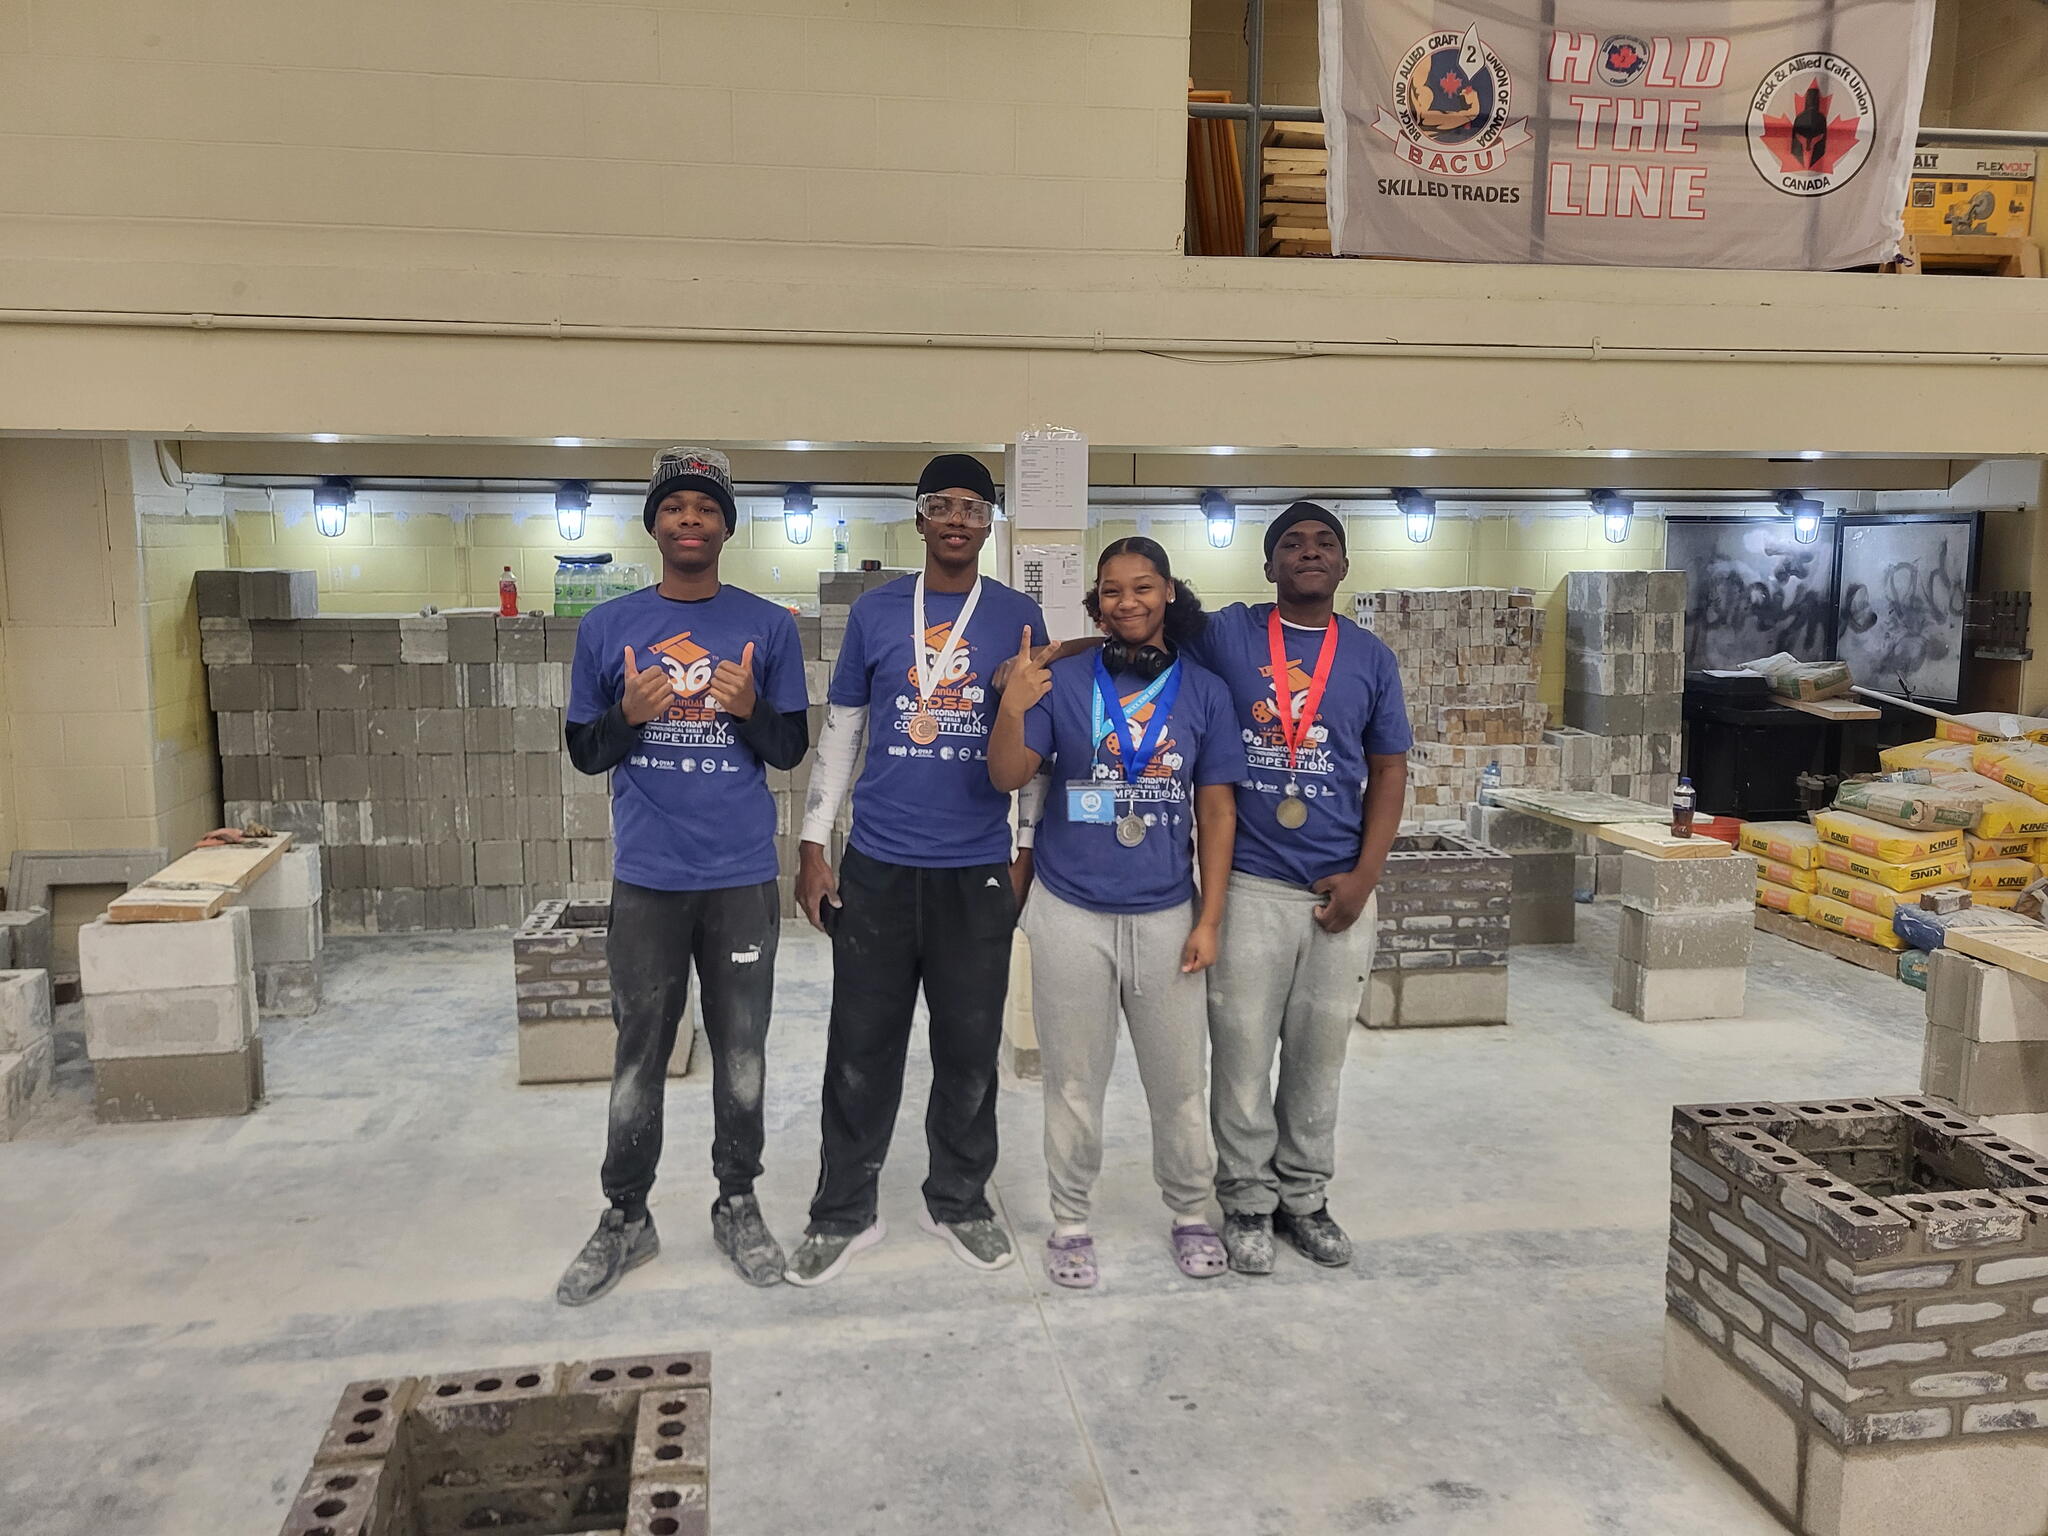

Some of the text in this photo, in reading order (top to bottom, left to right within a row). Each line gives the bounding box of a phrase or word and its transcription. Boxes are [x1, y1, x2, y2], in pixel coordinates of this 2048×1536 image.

[1466, 45, 1476, 63] 2
[1396, 34, 1459, 142] BRICK AND ALLIED CRAFT
[1754, 56, 1869, 116] Brick & Allied Craft Union
[1477, 52, 1508, 148] UNION OF CANADA
[1570, 94, 1701, 153] THE
[1408, 145, 1493, 173] BACU
[1913, 154, 1939, 168] ALT
[1976, 161, 2032, 172] FLEXVOLT
[1377, 179, 1520, 203] SKILLED TRADES
[1548, 162, 1707, 220] LINE
[1782, 176, 1831, 191] CANADA
[661, 656, 712, 691] 36
[894, 720, 988, 735] COTITIONS
[1248, 755, 1335, 772] OMPETTIONS
[2003, 774, 2025, 789] KING
[1115, 789, 1186, 800] MPETITIONS
[2019, 822, 2048, 834] KING
[1830, 831, 1849, 844] KING
[1929, 837, 1958, 853] KING
[1752, 840, 1768, 851] KING
[1999, 844, 2029, 856] KING
[1850, 863, 1870, 876] KING
[1910, 865, 1941, 880] KING
[1997, 876, 2028, 887] KING
[1832, 887, 1850, 899] KING
[1823, 913, 1844, 926] KING
